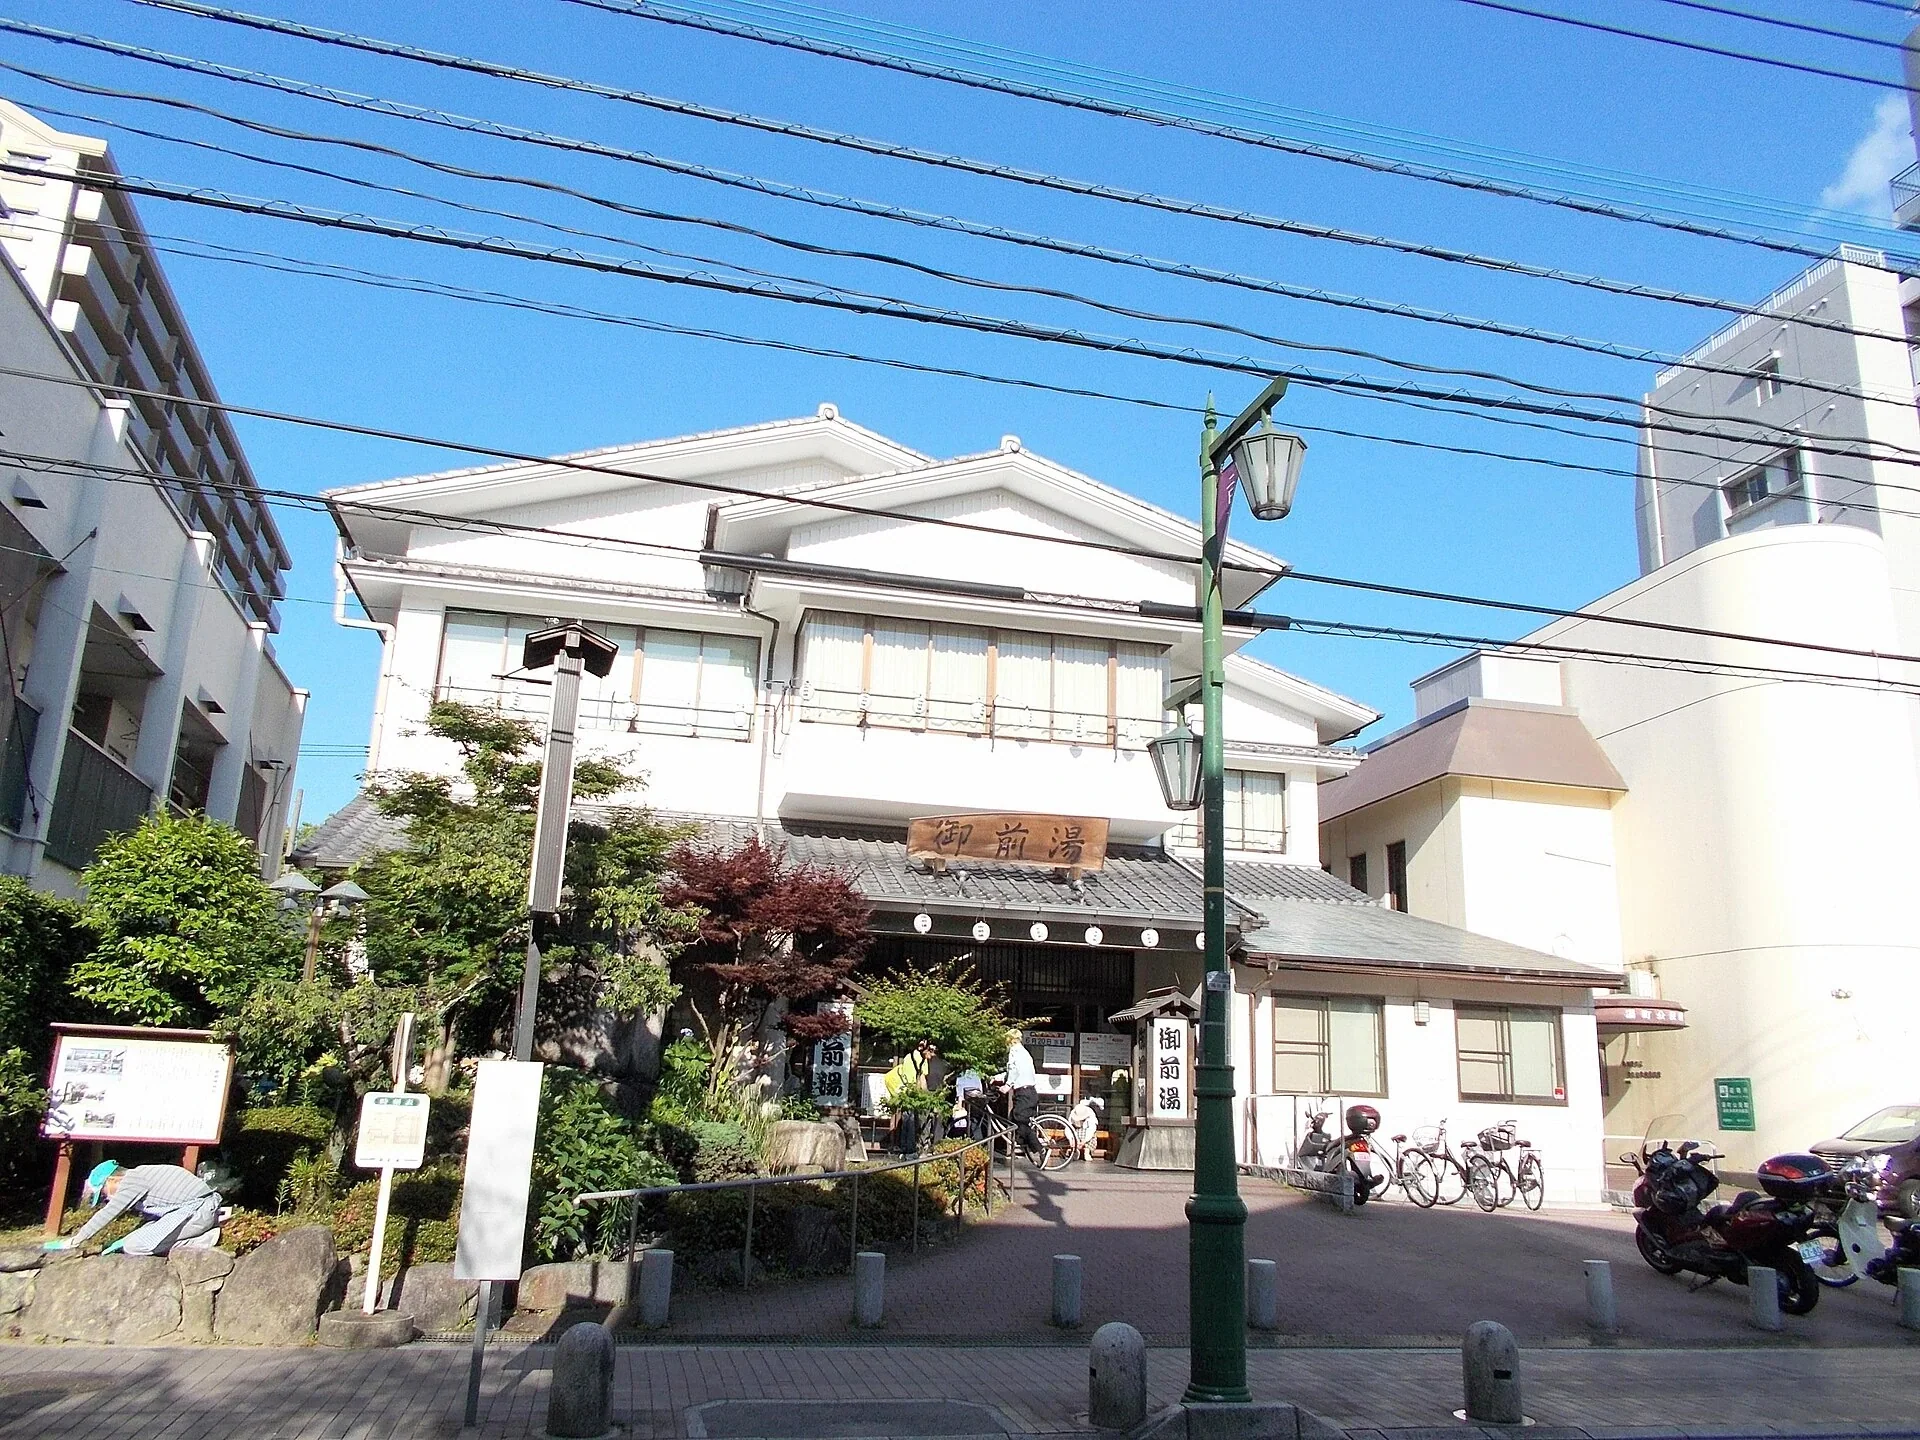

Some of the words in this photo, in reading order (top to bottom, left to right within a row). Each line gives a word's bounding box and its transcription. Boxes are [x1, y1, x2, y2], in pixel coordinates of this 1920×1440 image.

[933, 819, 1085, 864] 御前湯
[1159, 1027, 1181, 1110] 御前湯
